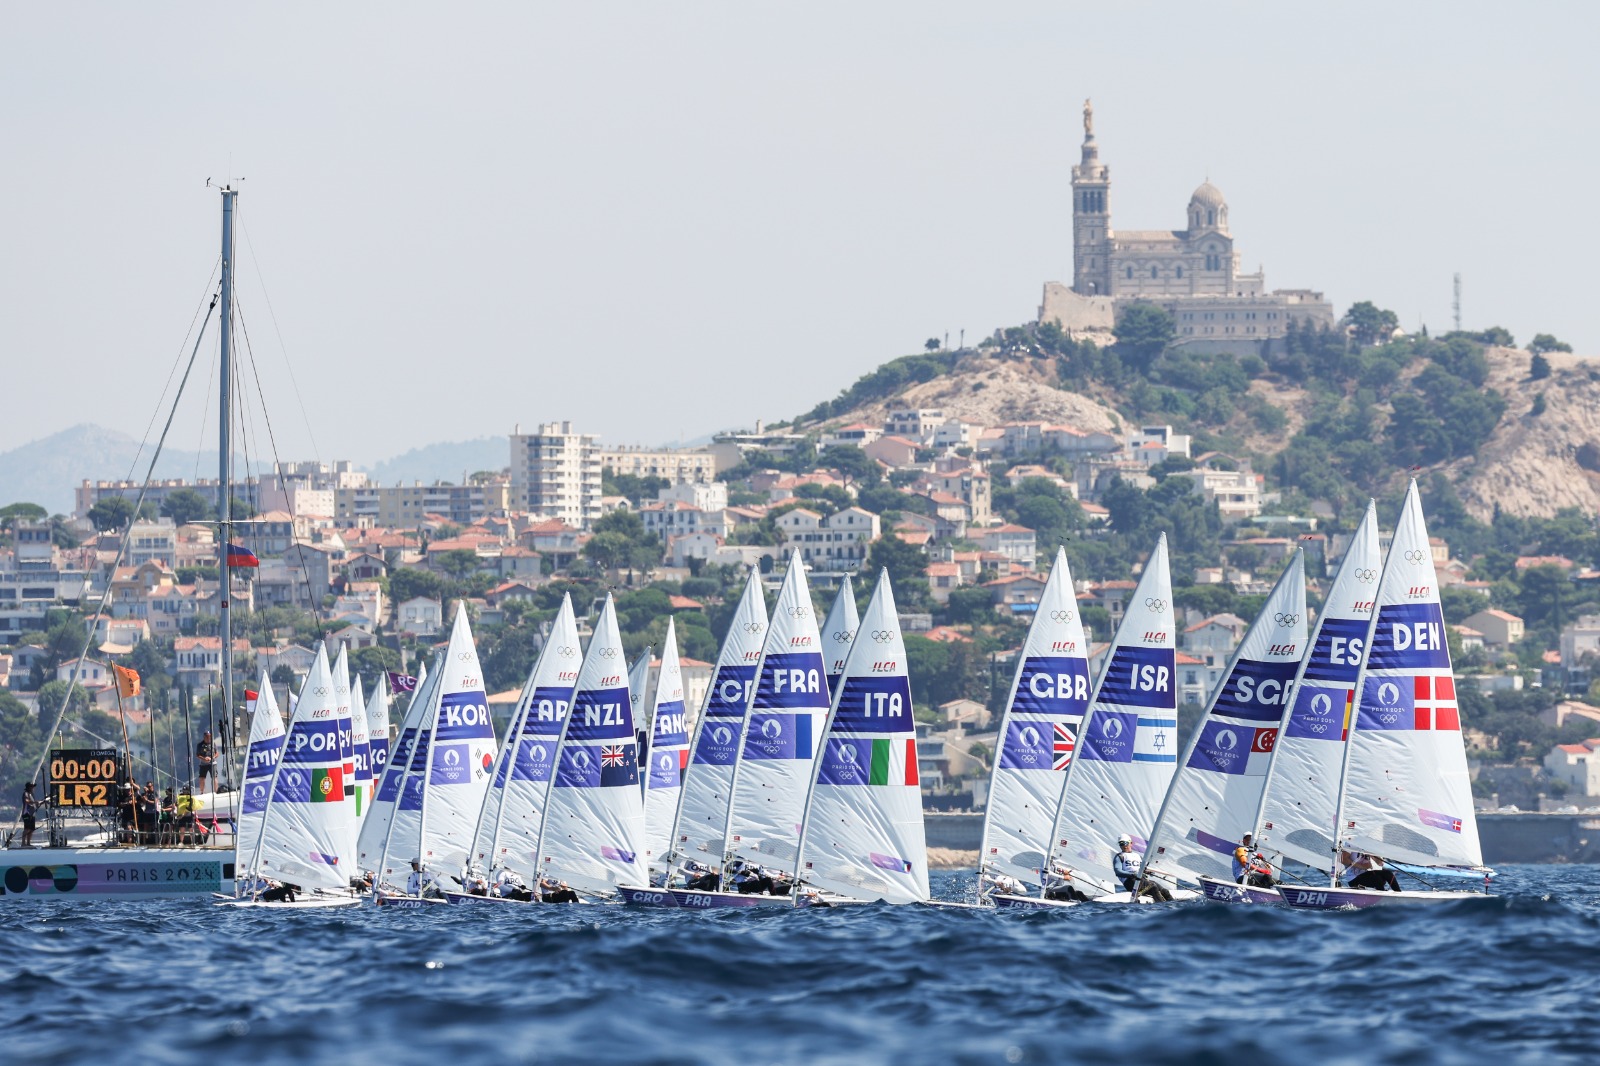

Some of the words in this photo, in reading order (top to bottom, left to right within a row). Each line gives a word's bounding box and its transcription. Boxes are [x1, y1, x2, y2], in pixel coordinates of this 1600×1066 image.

[1408, 587, 1429, 598] ILCA
[790, 637, 811, 647] ILCA
[1143, 632, 1166, 643] ILCA
[1392, 622, 1440, 651] DEN
[1051, 642, 1075, 652] ILCA
[1268, 645, 1295, 655] ILCA
[1330, 637, 1363, 666] ES
[744, 652, 760, 661] ILC
[834, 660, 844, 670] IL
[872, 662, 895, 672] ILCA
[397, 675, 416, 686] RC
[601, 675, 620, 686] ILCA
[774, 669, 819, 693] FRA
[1130, 664, 1169, 692] ISR
[673, 689, 682, 698] ILC
[1029, 672, 1088, 700] GBR
[538, 699, 568, 721] AR
[864, 692, 902, 717] ITA
[312, 709, 330, 718] ILCA
[446, 704, 488, 726] KOR
[584, 703, 624, 726] NZL
[295, 732, 336, 752] POR
[340, 730, 351, 747] GY
[253, 747, 281, 768] MN
[354, 754, 368, 770] RL
[371, 749, 386, 764] KG
[51, 760, 115, 779] 00:00
[58, 784, 107, 806] LR2
[165, 867, 213, 880] 2024
[685, 894, 711, 906] FRA
[1296, 892, 1328, 905] DEN
